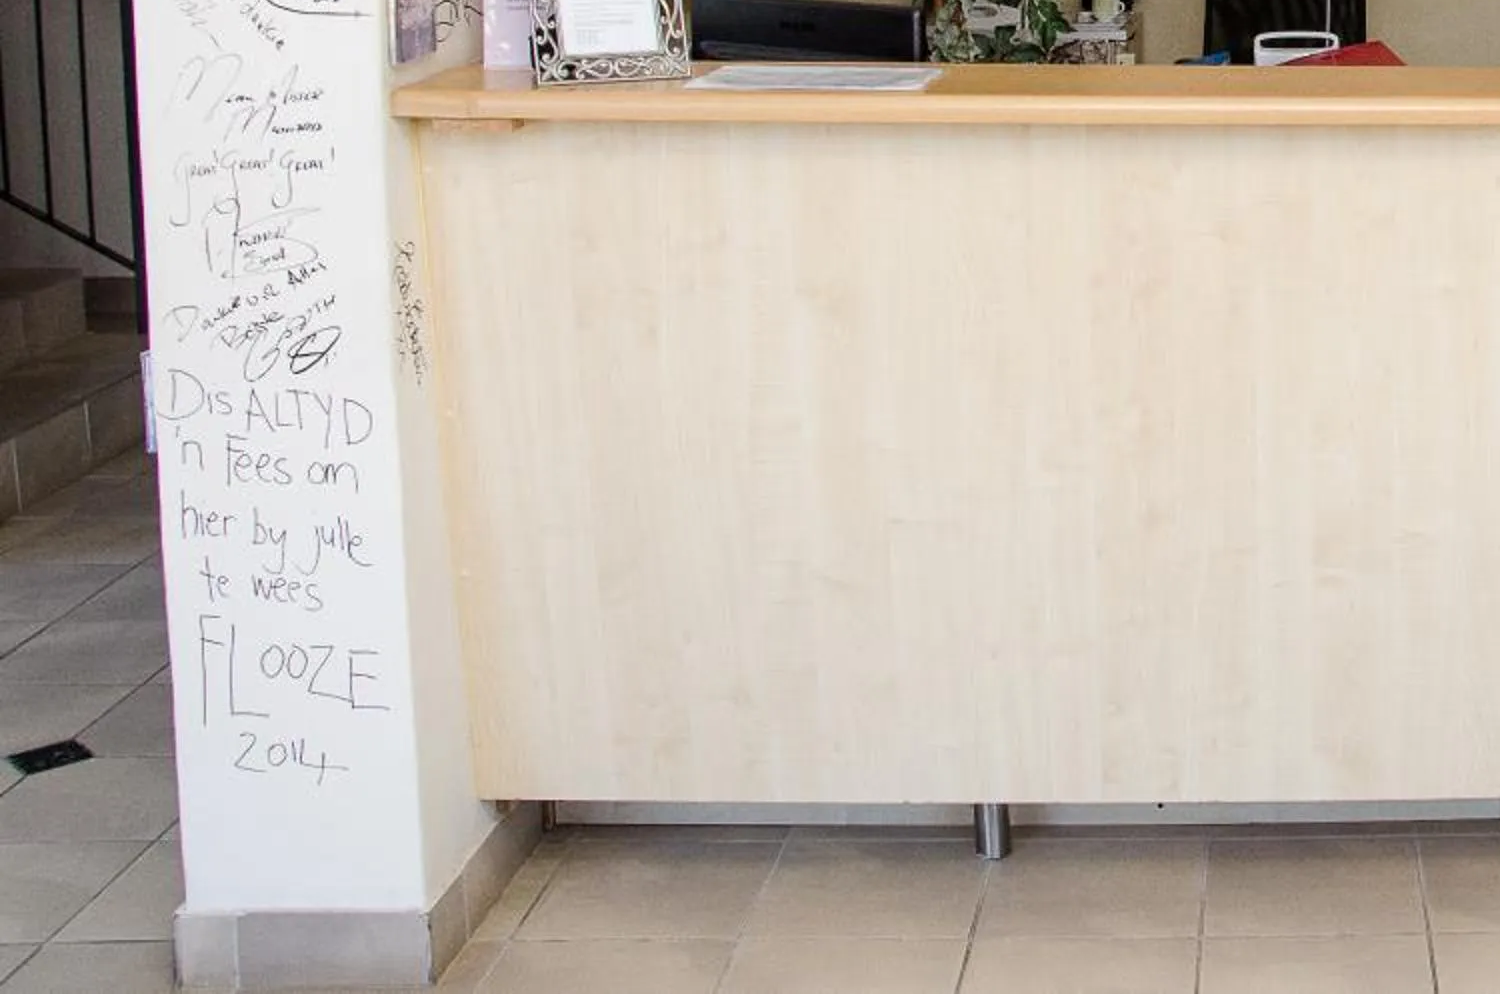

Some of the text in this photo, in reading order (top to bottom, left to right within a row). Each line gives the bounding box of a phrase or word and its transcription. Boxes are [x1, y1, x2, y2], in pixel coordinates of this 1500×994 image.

[245, 387, 374, 450] ALTYD
[225, 432, 293, 487] Fees
[307, 461, 359, 495] om
[180, 488, 375, 577] hier by julle
[199, 555, 324, 613] te wees
[199, 613, 391, 727] FLOOZE
[233, 730, 350, 786] 2014
